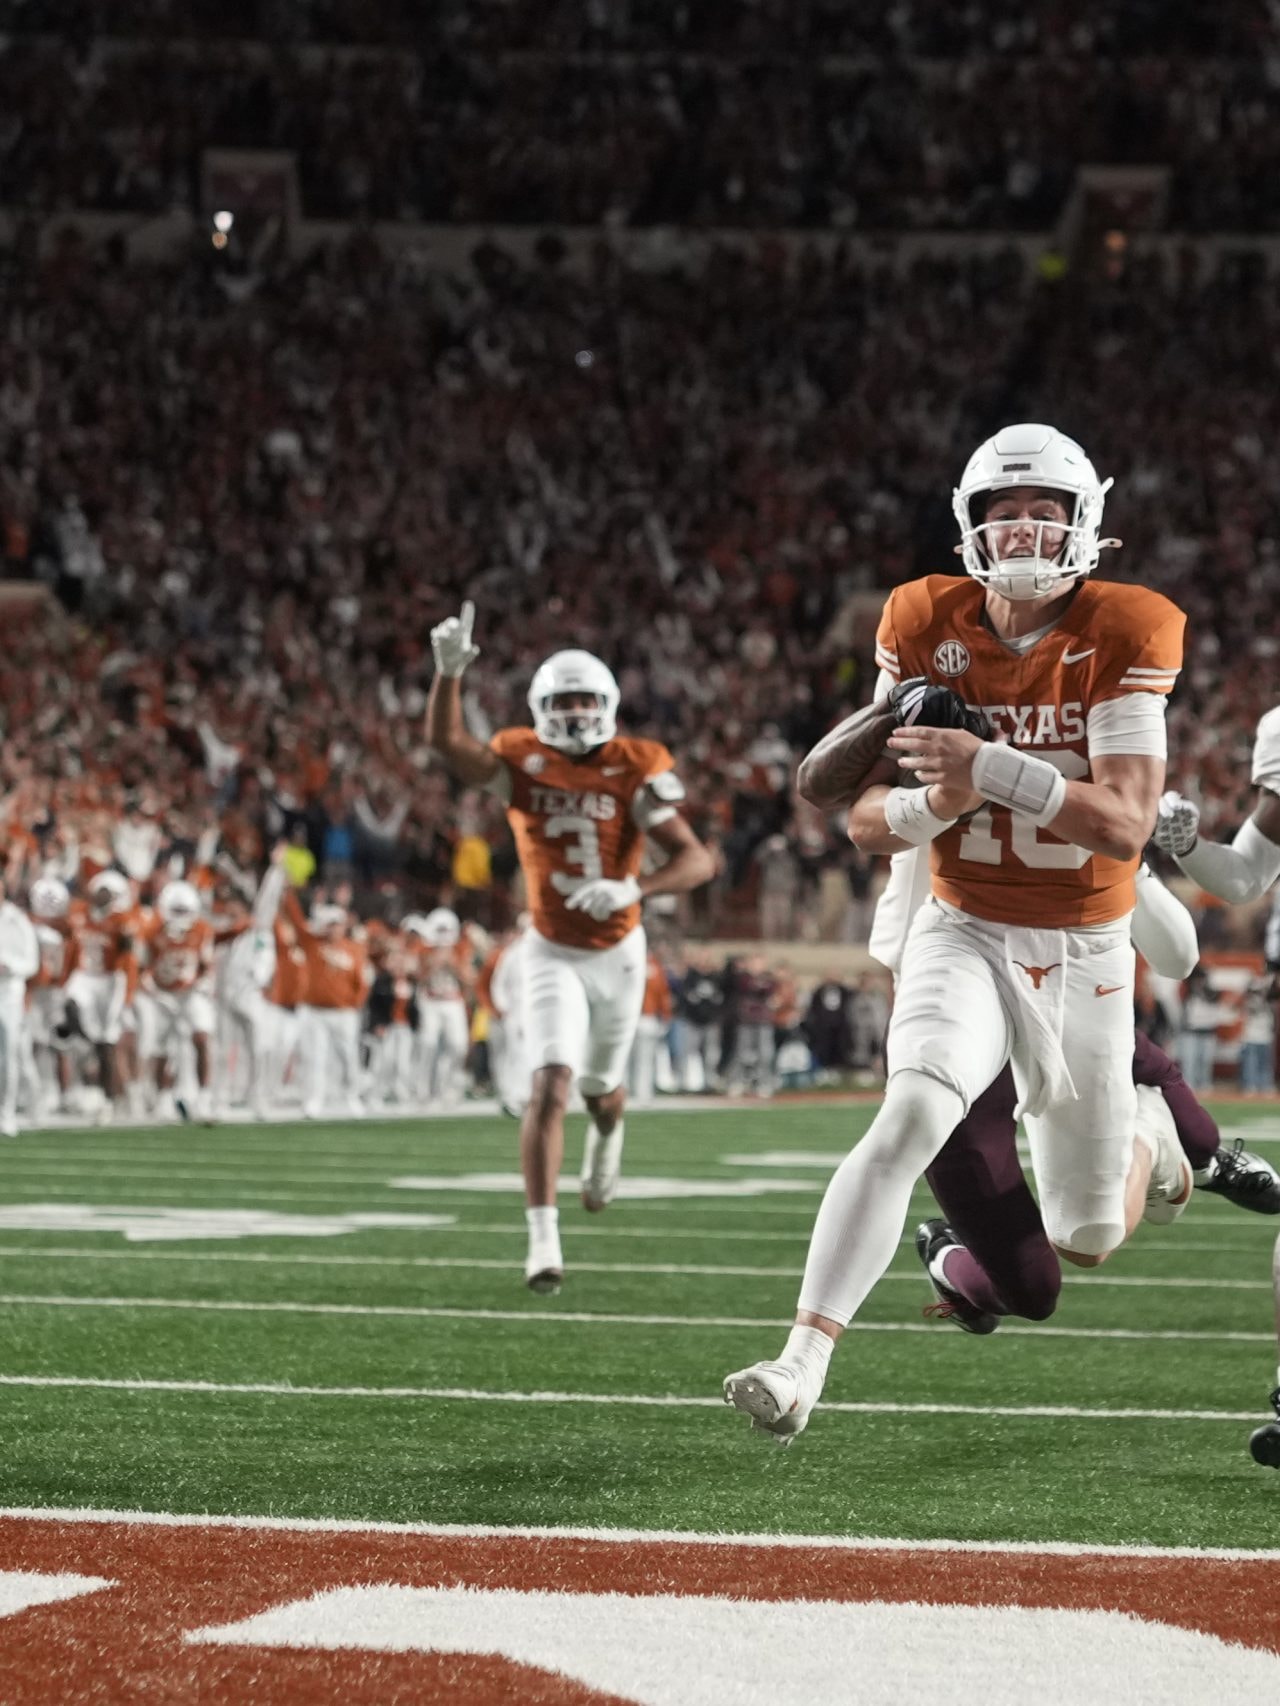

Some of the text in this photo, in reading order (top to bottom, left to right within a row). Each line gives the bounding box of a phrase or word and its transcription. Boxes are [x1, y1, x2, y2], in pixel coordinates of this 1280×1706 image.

[936, 641, 968, 675] SEC
[530, 787, 617, 822] TEXAS
[544, 815, 604, 896] 3
